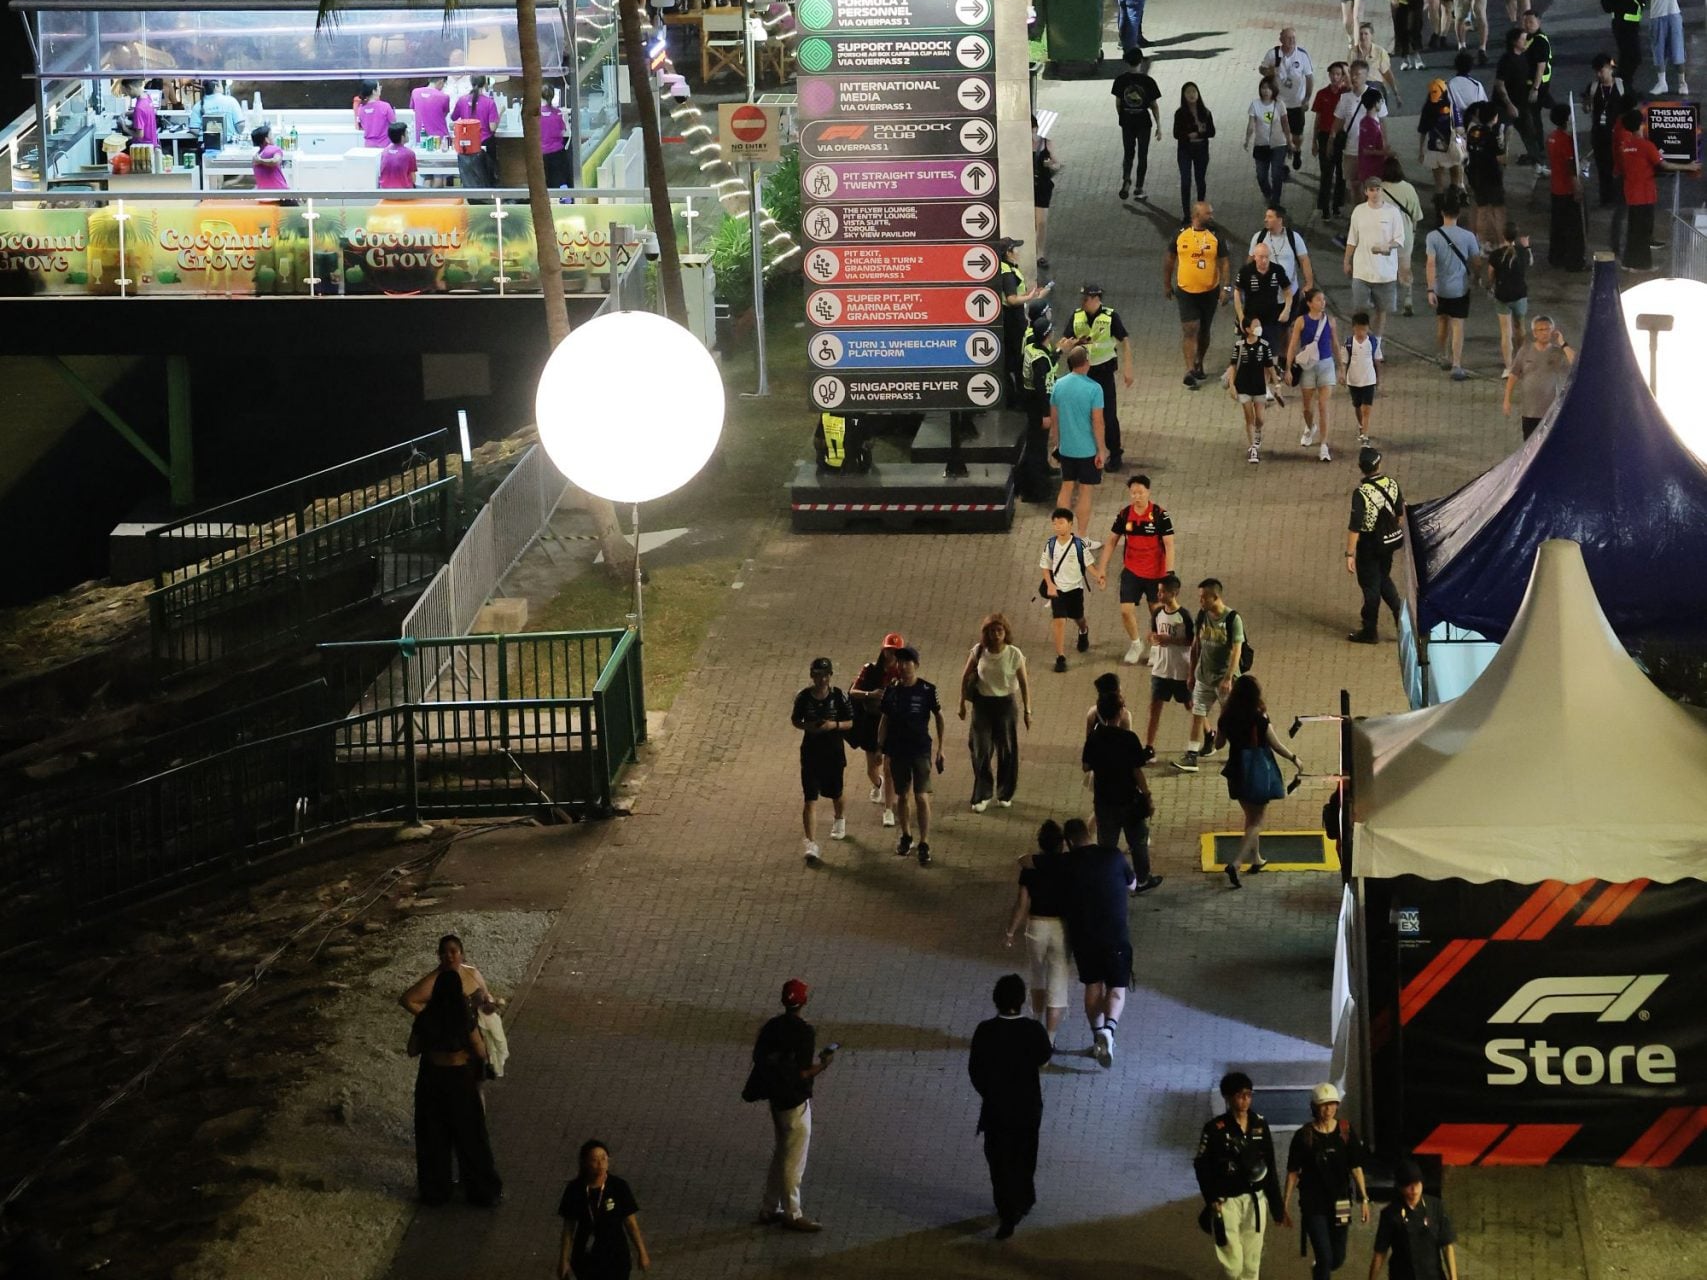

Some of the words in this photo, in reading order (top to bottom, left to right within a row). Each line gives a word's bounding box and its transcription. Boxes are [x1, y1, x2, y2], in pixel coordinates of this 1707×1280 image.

[838, 7, 912, 17] PERSONNEL
[855, 18, 903, 26] OVERPASS
[837, 42, 893, 52] SUPPORT
[895, 40, 952, 51] PADDOCK
[855, 58, 903, 66] OVERPASS
[840, 81, 940, 91] INTERNATIONAL
[840, 92, 881, 102] MEDIA
[873, 123, 953, 132] PADDOCK
[874, 131, 916, 140] CLUB
[835, 144, 883, 152] OVERPASS
[843, 173, 859, 181] PIT
[862, 172, 914, 181] STRAIGHT
[917, 171, 957, 180] SUITES,
[0, 230, 86, 251] conut
[160, 229, 272, 251] Coconut
[348, 226, 461, 251] Coconut
[178, 248, 256, 271] Grove
[366, 247, 445, 269] Grove
[844, 264, 911, 272] GRANDSTANDS
[847, 295, 881, 303] SUPER
[847, 303, 891, 312] MARINA
[893, 303, 913, 311] BAY
[847, 312, 928, 320] GRANDSTANDS
[848, 341, 878, 349] TURN
[889, 340, 957, 348] WHEELCHAIR
[848, 349, 904, 357] PLATFORM
[850, 382, 920, 392] SINGAPORE
[922, 381, 959, 391] FLYER
[850, 393, 865, 401] VIA
[1484, 1038, 1677, 1085] Store
